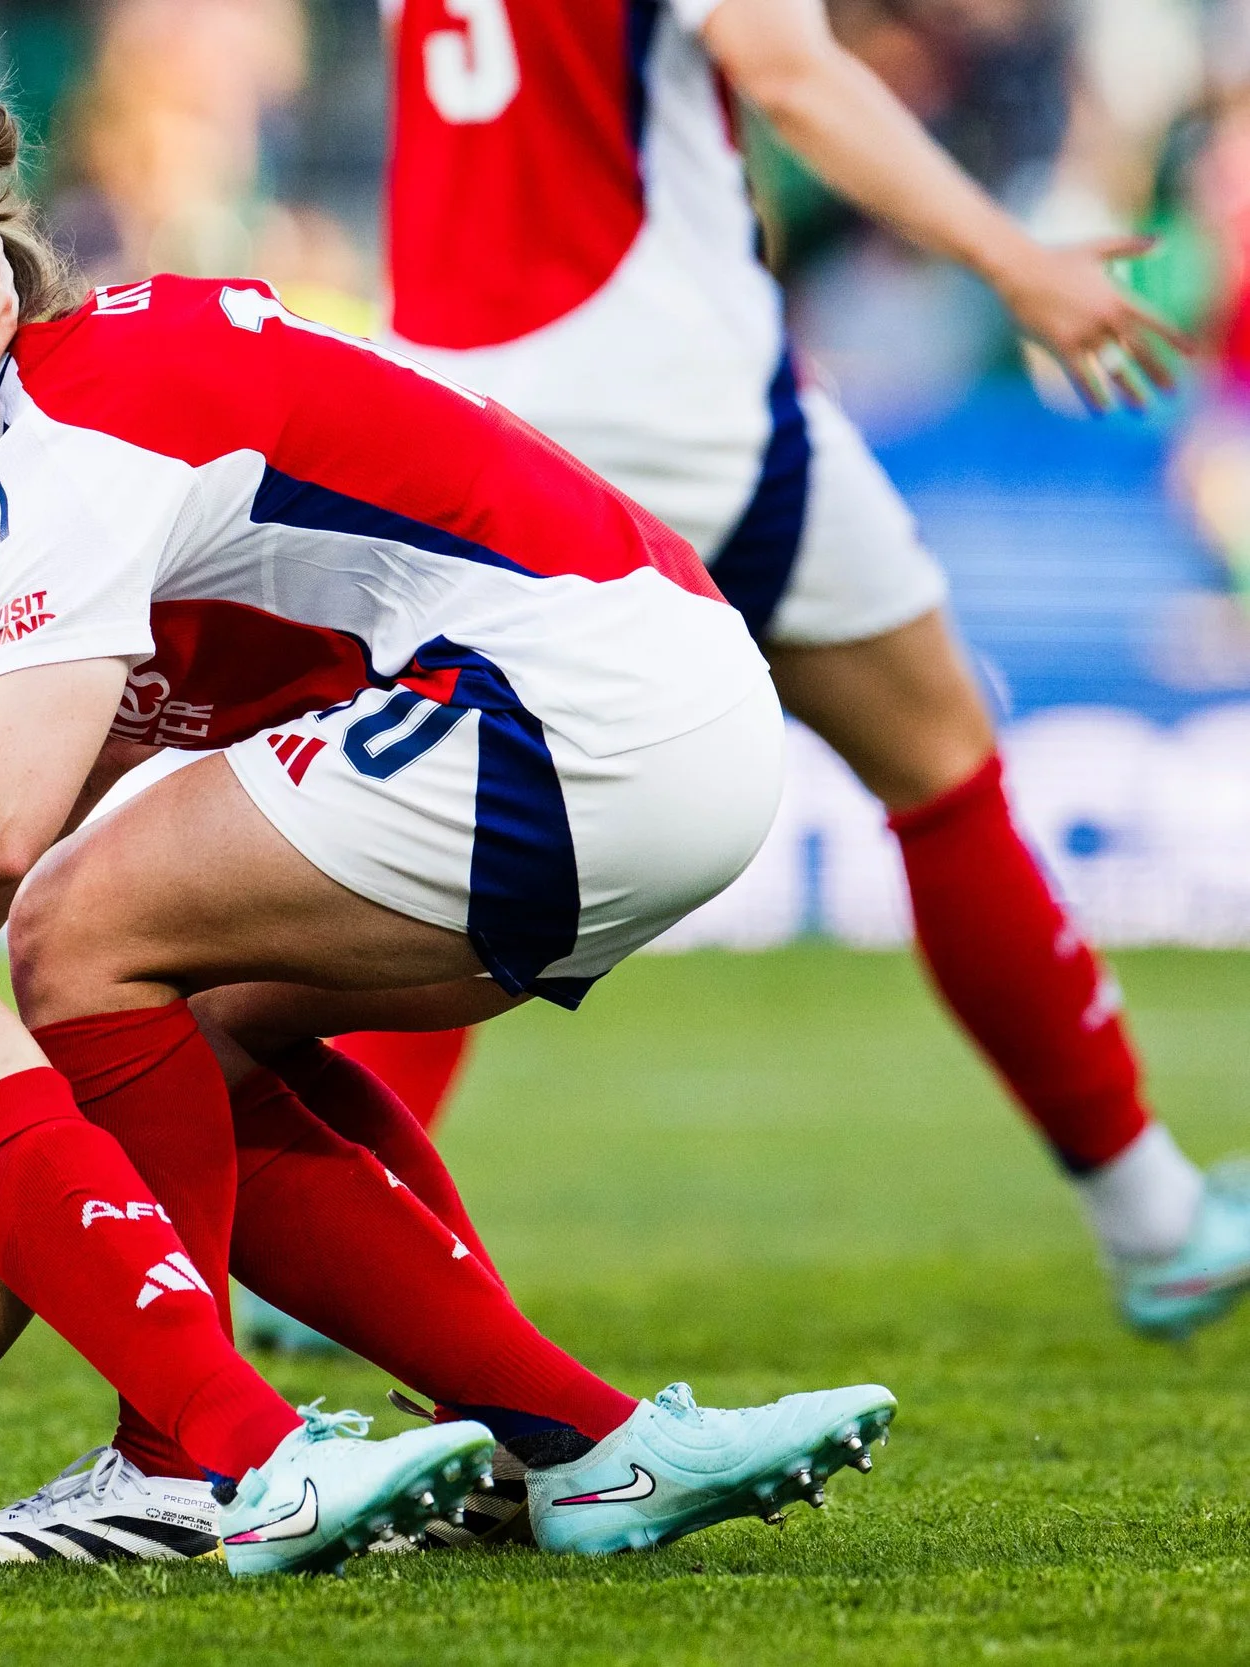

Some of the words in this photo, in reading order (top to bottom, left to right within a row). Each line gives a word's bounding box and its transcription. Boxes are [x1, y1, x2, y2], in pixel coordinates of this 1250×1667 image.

[163, 1494, 217, 1510] PREDATOR
[178, 1513, 196, 1523] UWCL
[197, 1518, 213, 1527] FINAL
[190, 1523, 212, 1532] LISBON
